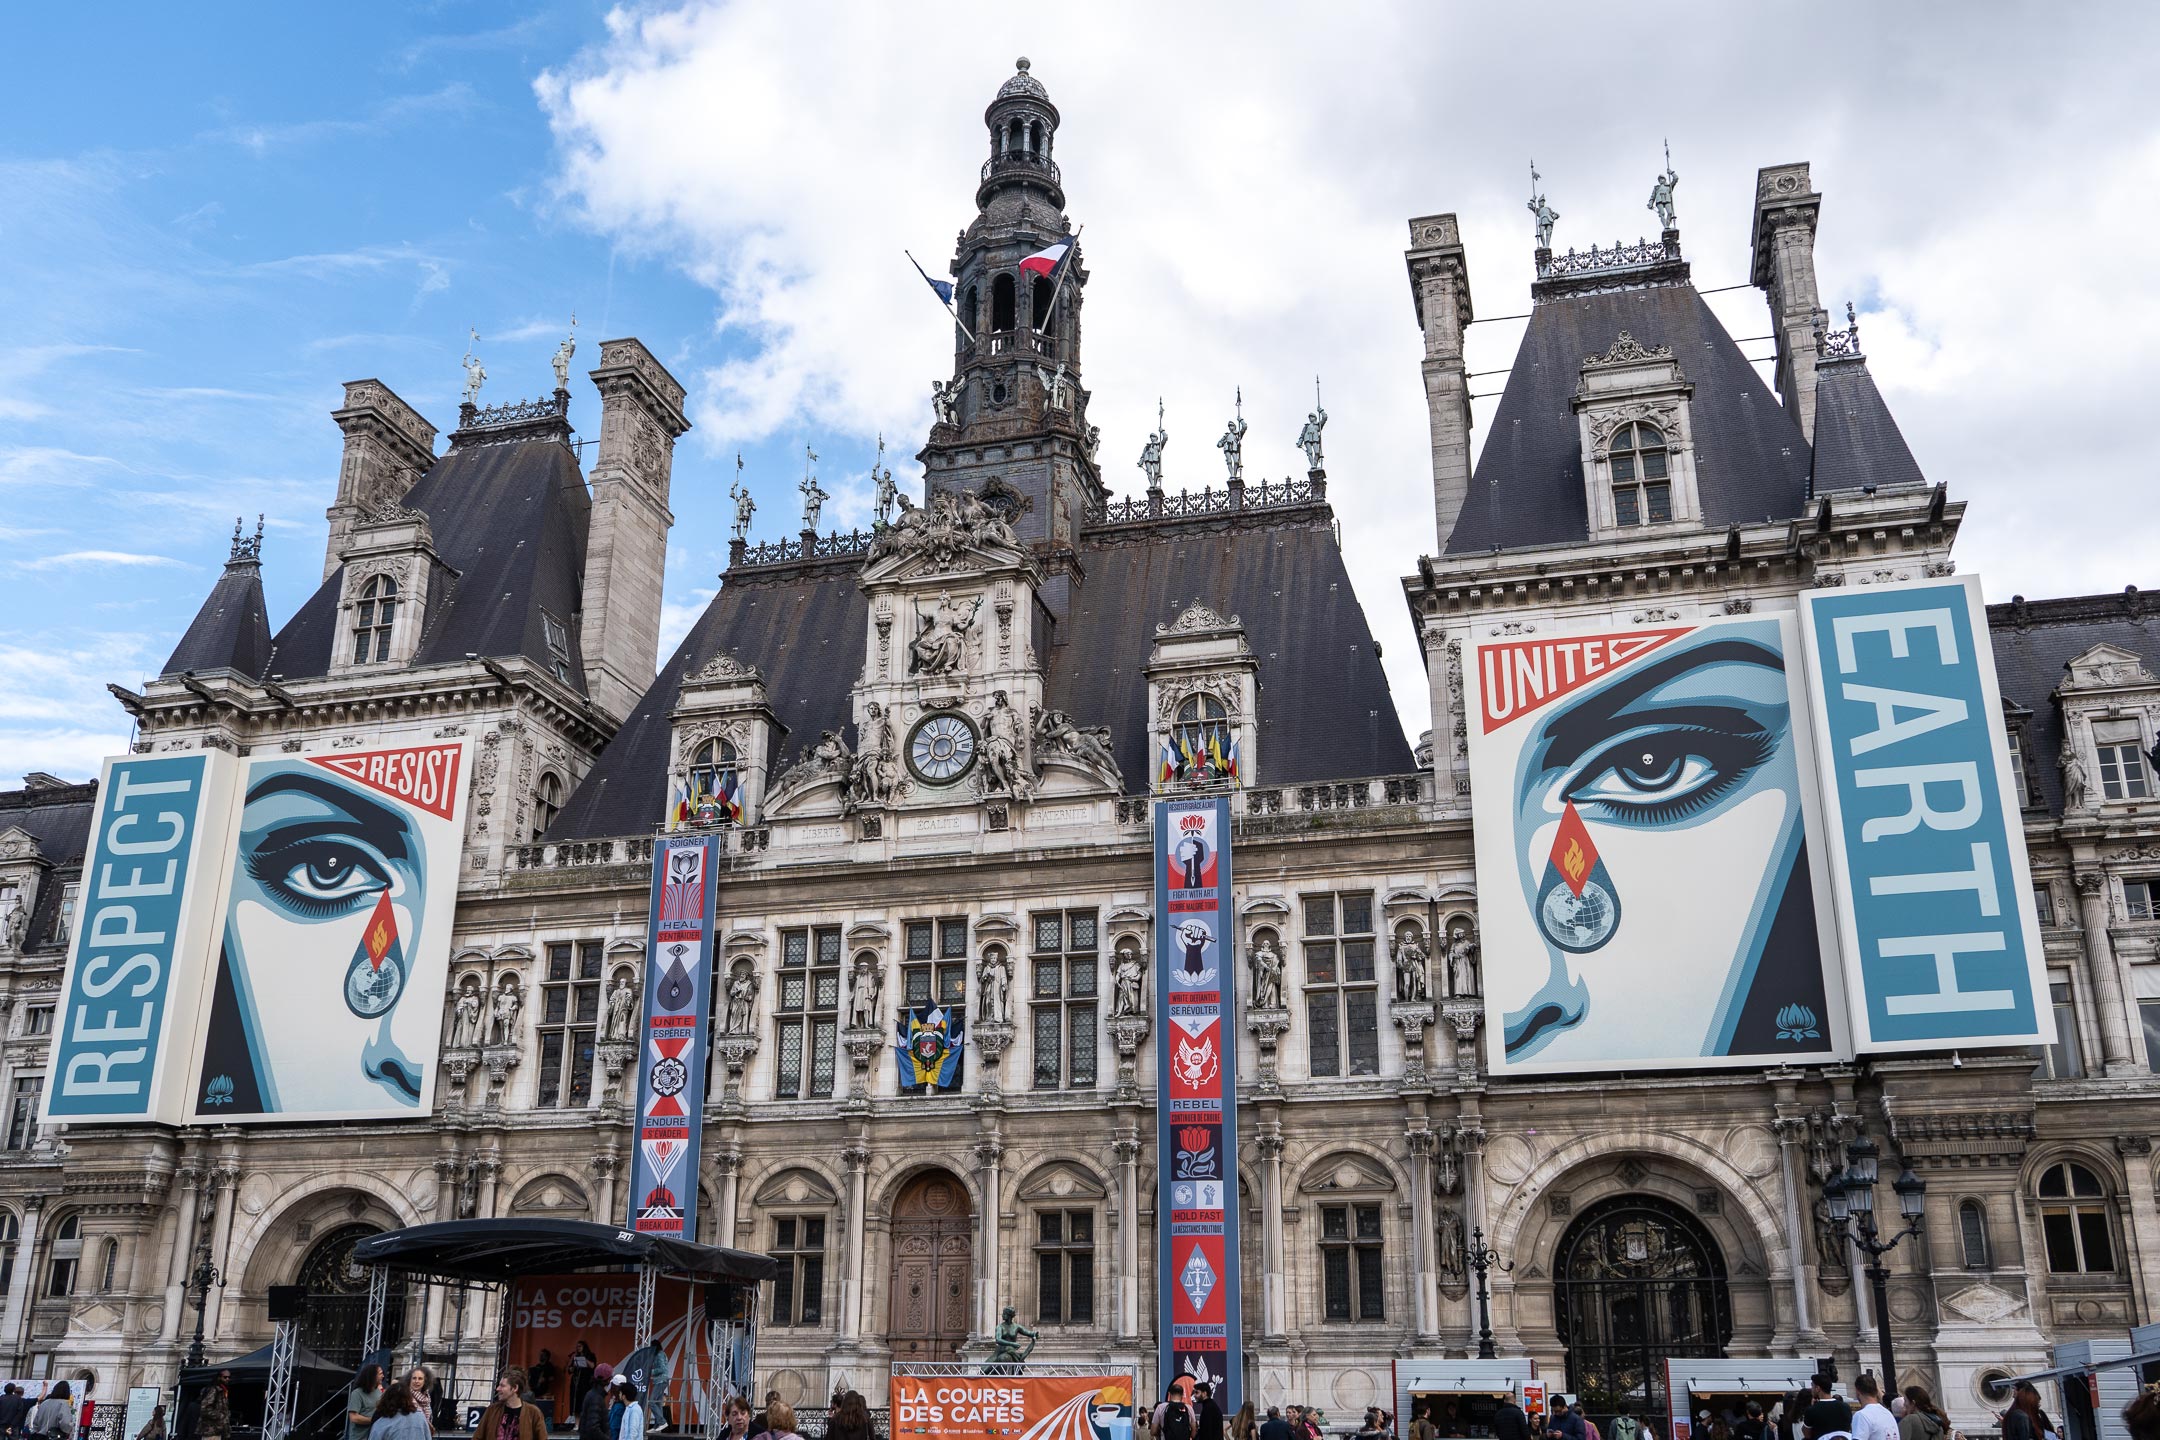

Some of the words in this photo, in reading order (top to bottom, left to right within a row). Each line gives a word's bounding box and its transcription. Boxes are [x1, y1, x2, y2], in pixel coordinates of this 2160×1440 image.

[1482, 645, 1605, 721] UNITE
[368, 747, 460, 811] RESIST
[1030, 807, 1088, 822] FRATERNITÉ
[1832, 607, 2017, 1017] EARTH
[916, 816, 960, 830] ÉGALITÉ
[802, 826, 840, 840] LIBERTÉ
[669, 838, 704, 848] SOIGNER
[1172, 890, 1188, 899] FIGHT
[1189, 890, 1202, 899] WITH
[1204, 889, 1214, 897] ART
[1186, 901, 1204, 910] MALGRÉ
[1204, 902, 1216, 910] TOUT
[663, 920, 697, 929] HEAL
[62, 770, 192, 1098] RESPECT
[658, 932, 699, 941] S'ENTRAIDER
[1172, 994, 1188, 1002] WRITE
[1190, 994, 1216, 1002] DEFIANTLY
[1171, 1006, 1181, 1015] SE
[1182, 1005, 1218, 1015] RÉVOLTER
[654, 1018, 691, 1027] UNITE
[653, 1028, 691, 1038] ESPÉRER
[1173, 1100, 1219, 1109] REBEL
[646, 1118, 686, 1126] ENDURE
[1172, 1113, 1196, 1123] CONTINUER
[1198, 1114, 1203, 1122] DE
[1204, 1113, 1220, 1122] CROIRE
[648, 1128, 682, 1138] S'ÉVADER
[1174, 1212, 1197, 1221] HOLD
[1200, 1212, 1221, 1220] FAST
[640, 1221, 661, 1230] BREAK
[664, 1220, 679, 1229] OUT
[1178, 1224, 1201, 1234] RÉSISTANCE
[1201, 1225, 1222, 1234] POLITIQUE
[516, 1288, 547, 1306] LA
[515, 1310, 562, 1328] DES
[1175, 1326, 1199, 1335] POLITICAL
[1200, 1326, 1224, 1334] DEFIANCE
[1179, 1340, 1220, 1349] LUTTER
[900, 1388, 929, 1404] LA
[936, 1388, 1024, 1404] COURSE
[900, 1406, 944, 1422] DES
[951, 1404, 1025, 1423] CAFÉS
